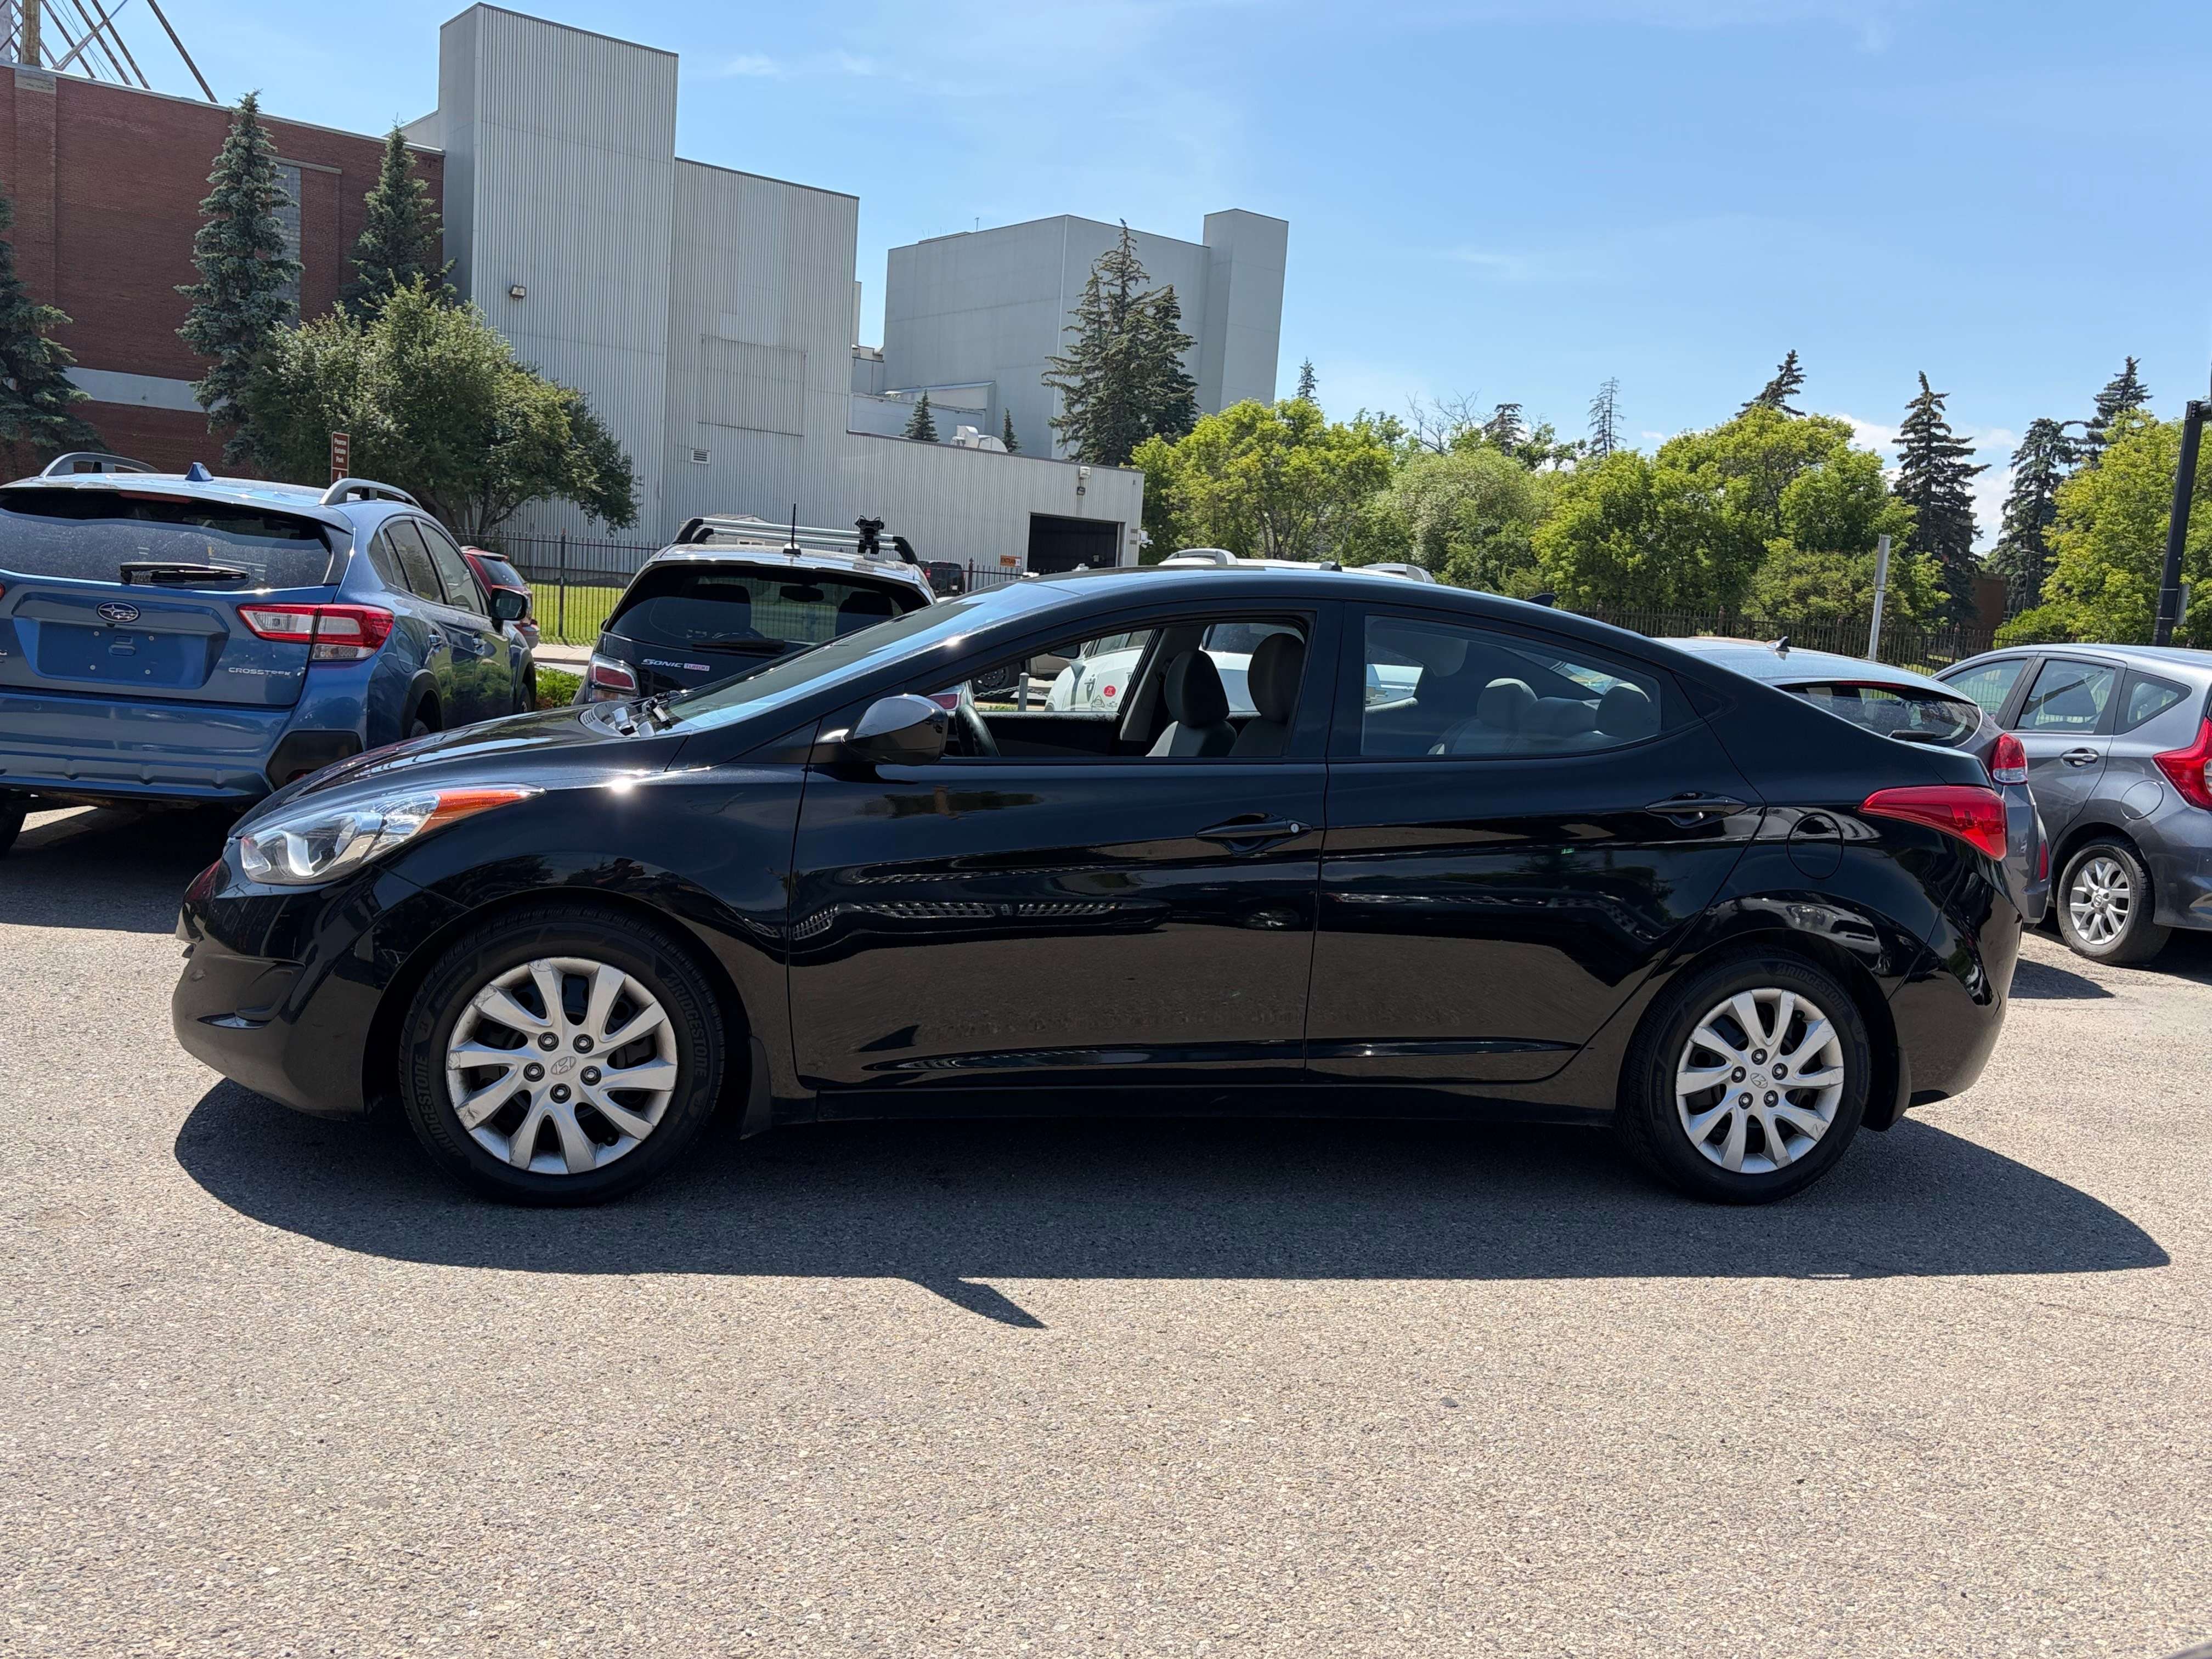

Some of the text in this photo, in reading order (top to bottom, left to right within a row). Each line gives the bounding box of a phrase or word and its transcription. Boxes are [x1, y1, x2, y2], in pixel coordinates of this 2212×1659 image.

[334, 447, 346, 455] Estate
[228, 667, 291, 676] CROSSTREK
[641, 658, 683, 668] SONIC
[1775, 962, 1849, 1013] BRIDGESTONE
[662, 971, 707, 1077] BRIDGESTONE
[414, 1054, 465, 1158] BRIDGESTONE
